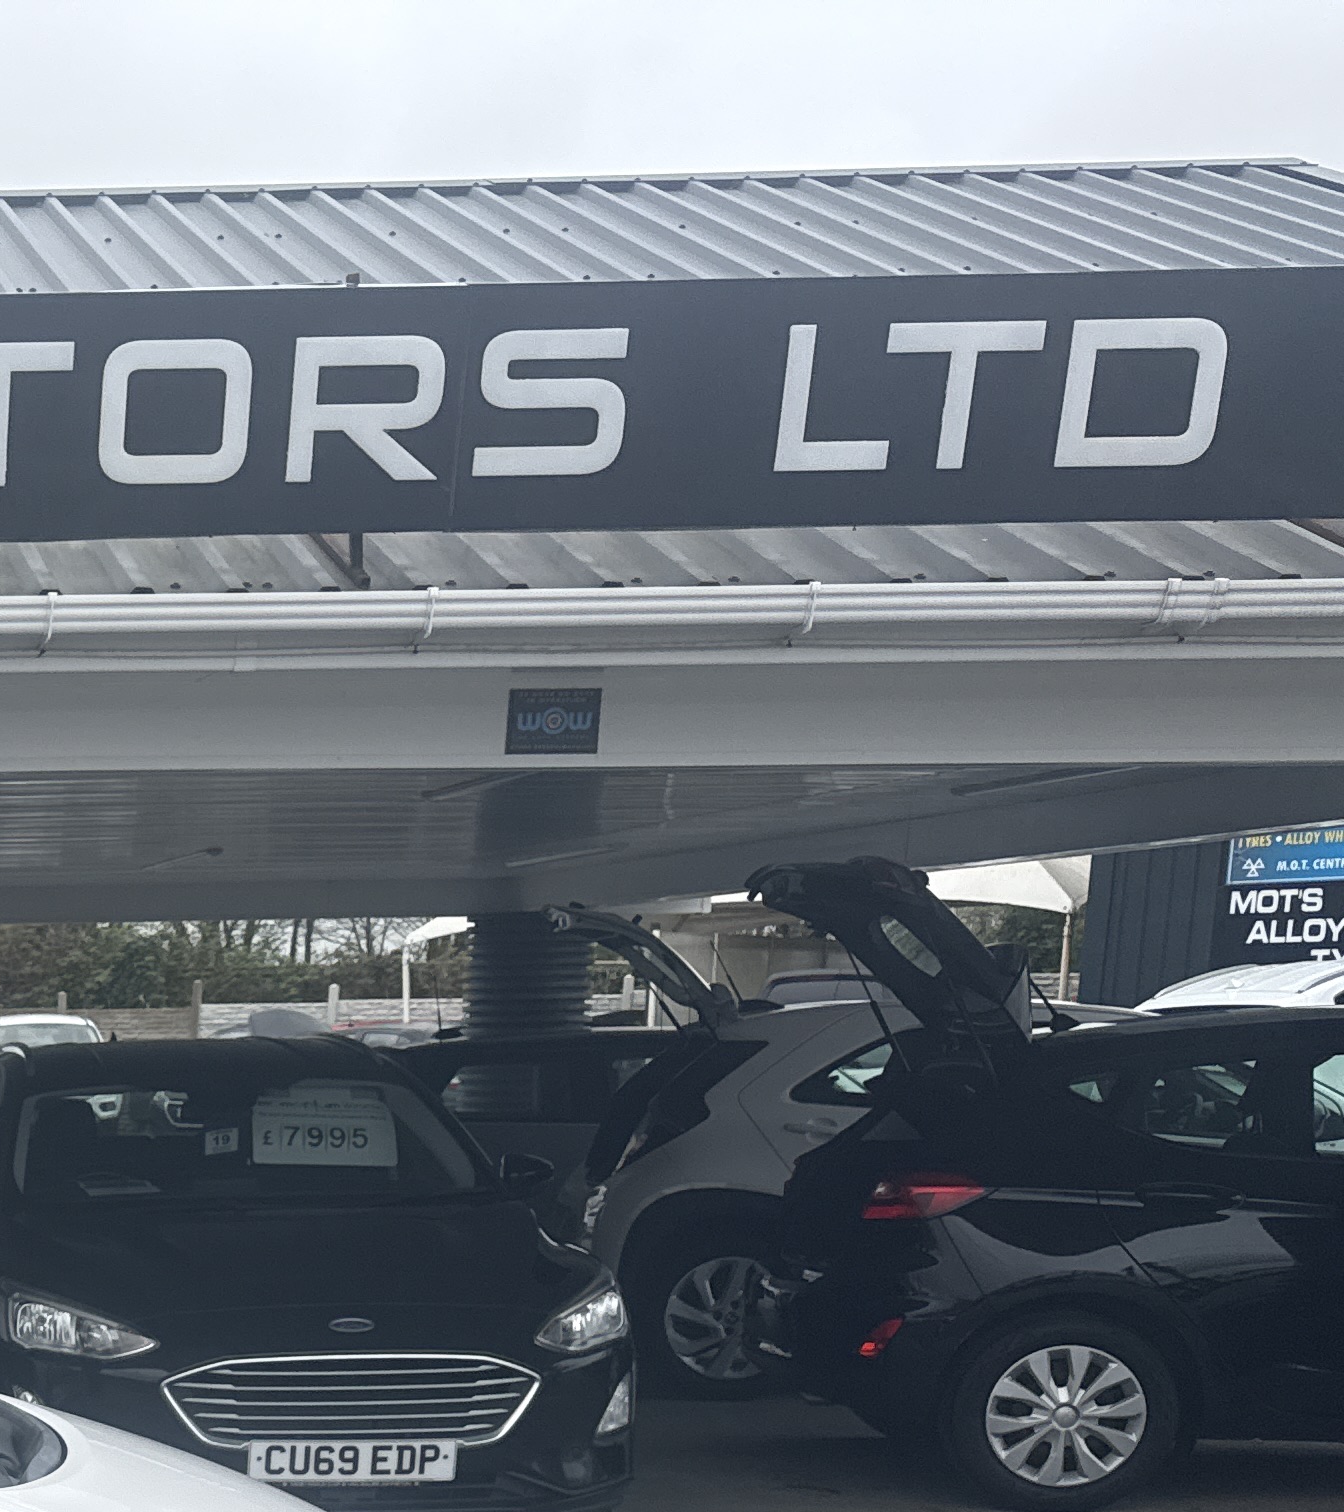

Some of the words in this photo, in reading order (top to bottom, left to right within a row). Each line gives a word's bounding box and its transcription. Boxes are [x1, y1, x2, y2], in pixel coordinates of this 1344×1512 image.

[774, 317, 1228, 472] LTD
[1283, 831, 1321, 845] ALLOY
[1229, 887, 1324, 914] MOT'S
[1245, 917, 1344, 944] ALLOY
[264, 1444, 360, 1476] CU69
[370, 1444, 441, 1476] EDP
